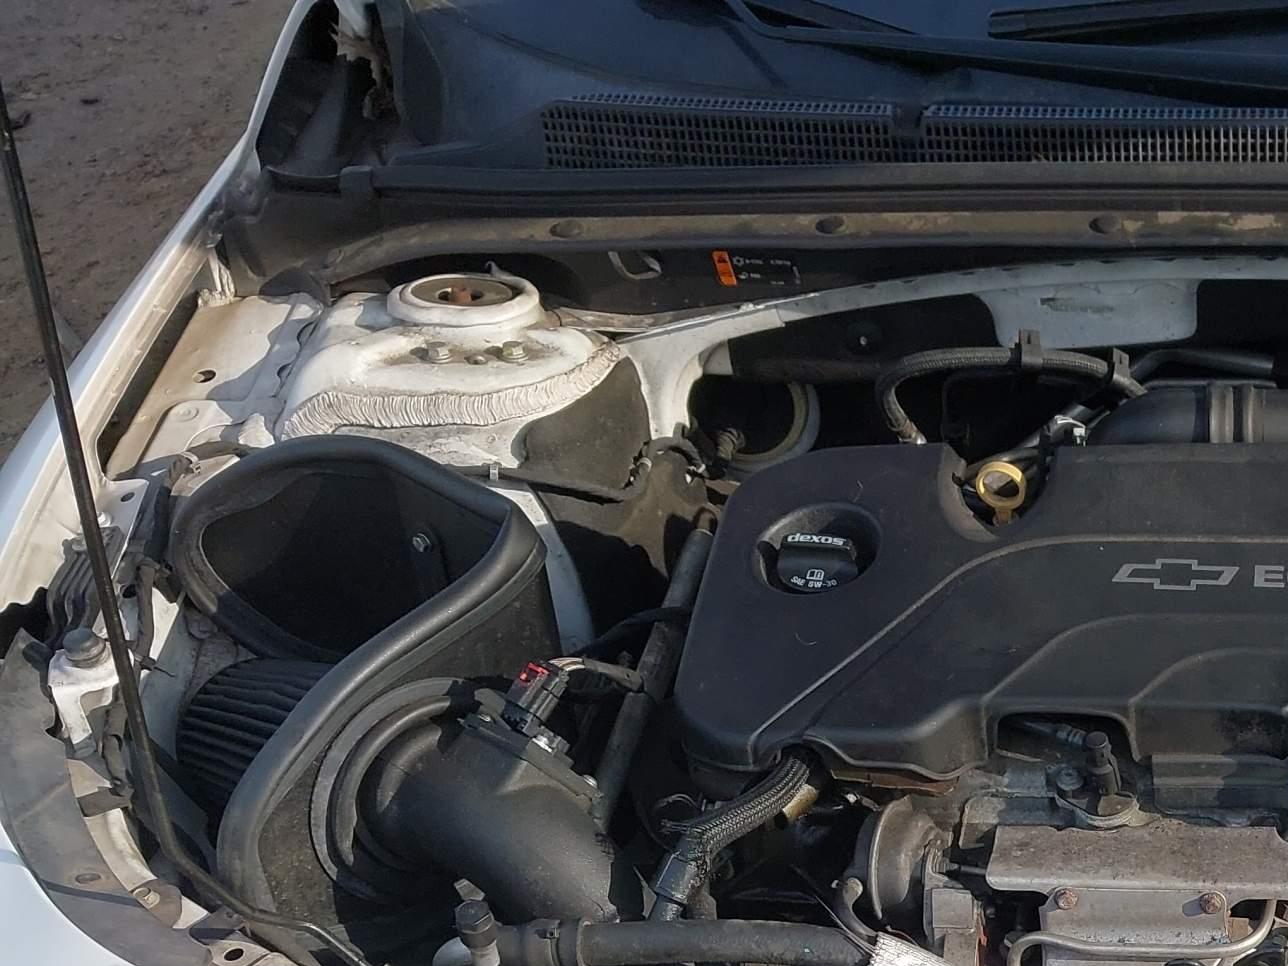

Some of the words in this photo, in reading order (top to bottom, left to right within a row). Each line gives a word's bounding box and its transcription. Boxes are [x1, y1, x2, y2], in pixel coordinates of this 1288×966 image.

[787, 533, 847, 546] dexos
[790, 575, 806, 586] SAE
[807, 578, 838, 588] 5W-30
